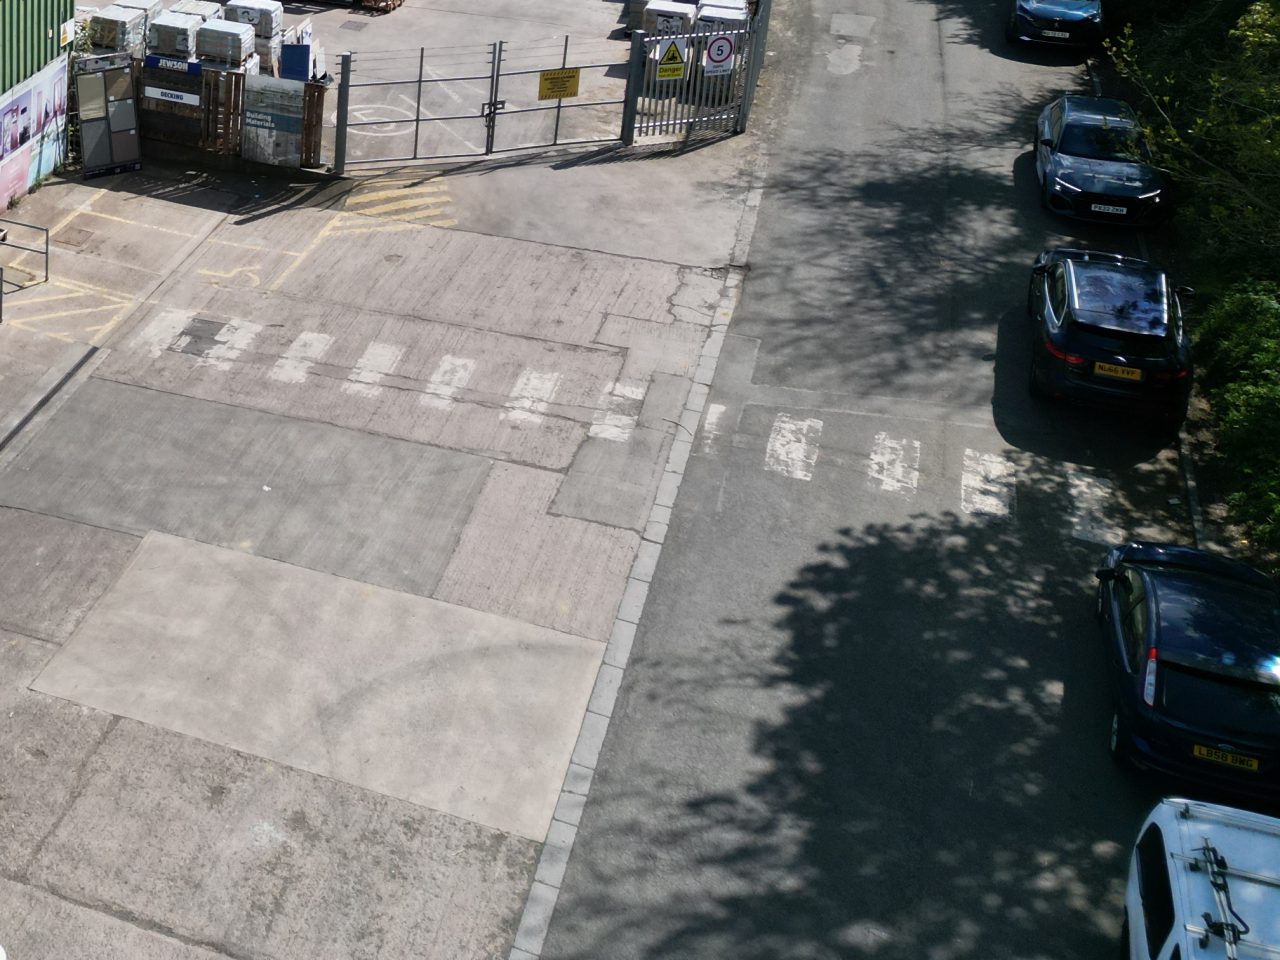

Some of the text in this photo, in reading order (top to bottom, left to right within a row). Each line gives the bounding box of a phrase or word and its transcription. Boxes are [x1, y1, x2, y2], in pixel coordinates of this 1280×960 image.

[716, 45, 724, 56] 5
[158, 58, 188, 72] JEWSON
[160, 91, 184, 100] DECKING
[246, 111, 272, 122] Building
[245, 117, 275, 128] Materials
